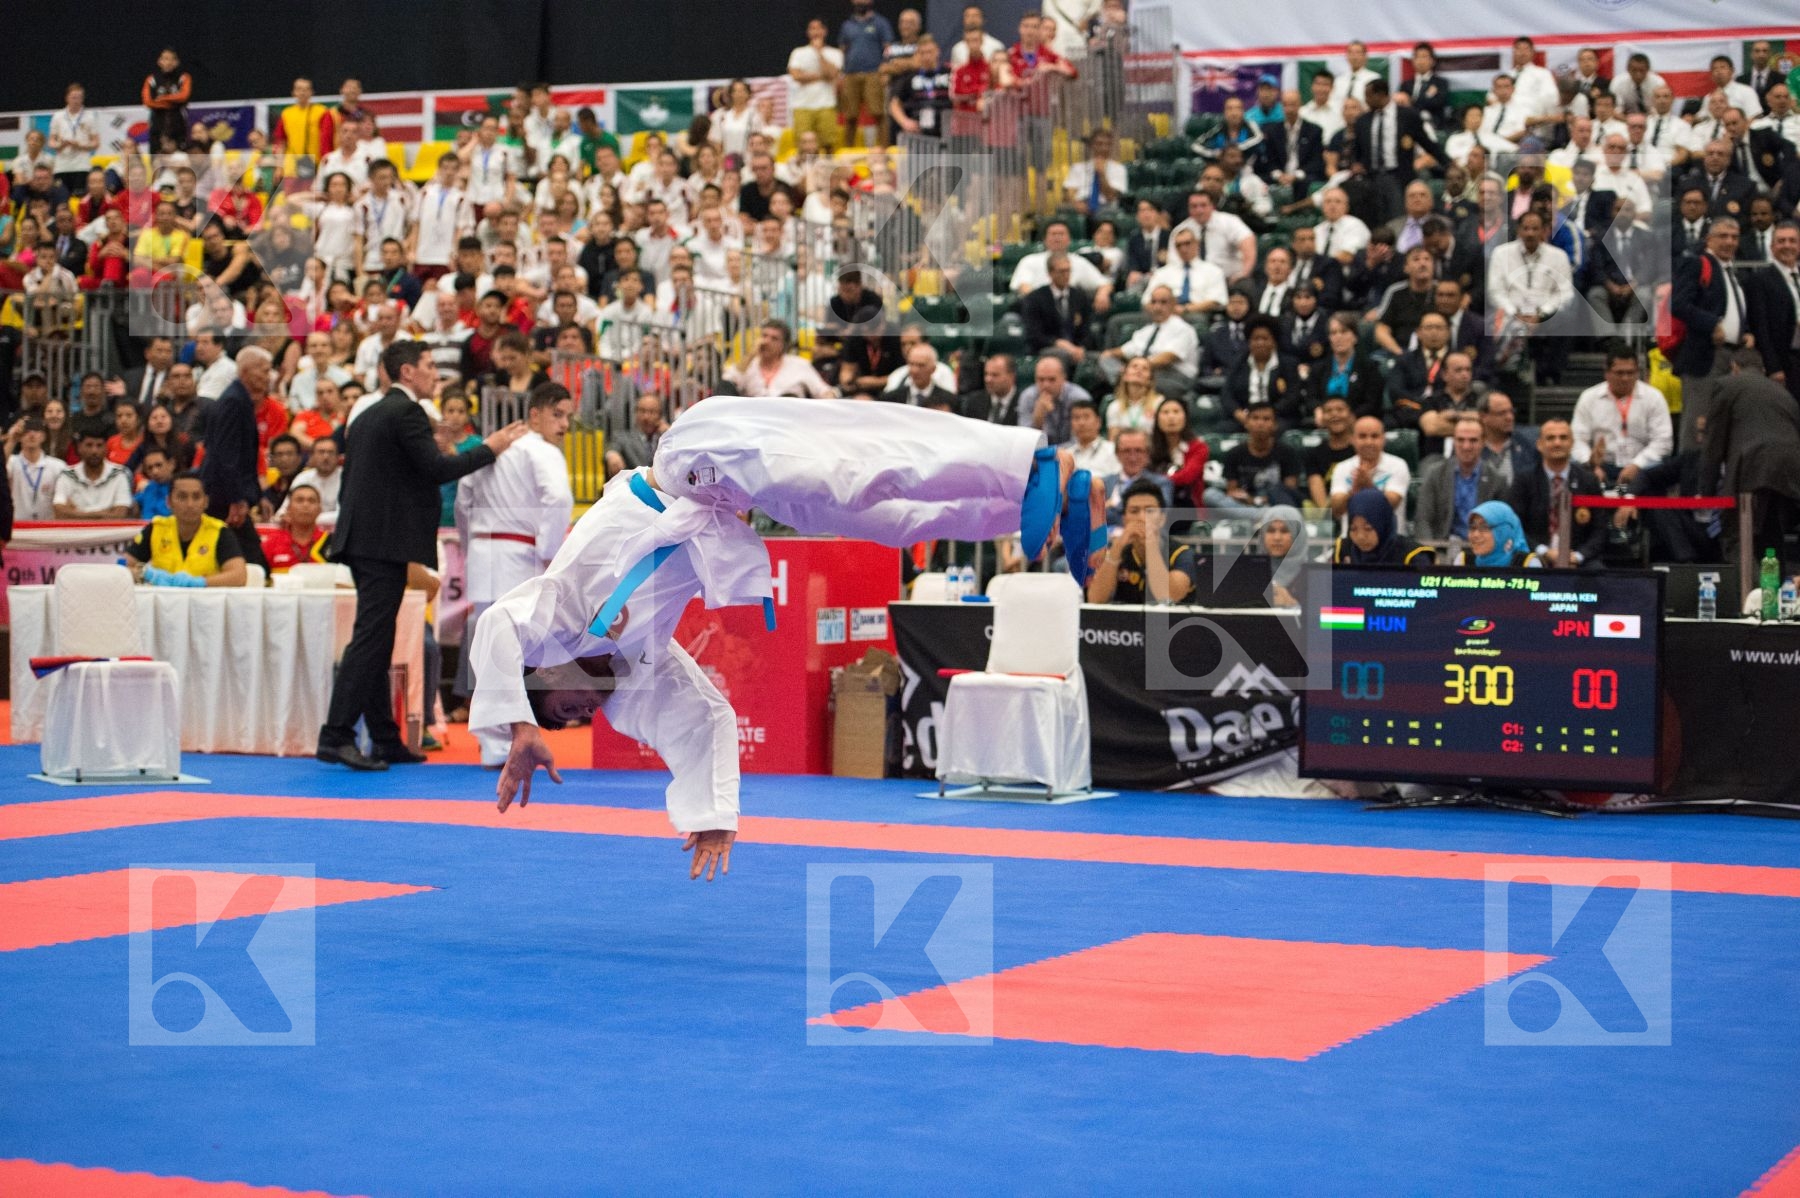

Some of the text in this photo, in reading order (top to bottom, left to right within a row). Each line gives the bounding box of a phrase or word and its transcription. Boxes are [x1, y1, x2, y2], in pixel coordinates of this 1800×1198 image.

[1420, 576, 1441, 588] U21
[1442, 577, 1479, 589] Kumite
[1481, 577, 1506, 590] Male
[1525, 578, 1540, 592] kg
[1375, 599, 1417, 609] HUNGARY
[1579, 593, 1598, 603] KEN
[1549, 603, 1578, 613] JAPAN
[1367, 615, 1407, 633] HUN
[1552, 620, 1591, 638] JPN
[1078, 628, 1145, 647] PONSOR
[1730, 649, 1800, 665] www.wk
[1342, 661, 1384, 700] 00
[1444, 664, 1514, 706] 3:00
[1572, 668, 1618, 710] 00
[737, 726, 766, 743] ATE
[1502, 722, 1524, 735] C1:
[1502, 739, 1524, 752] C2:
